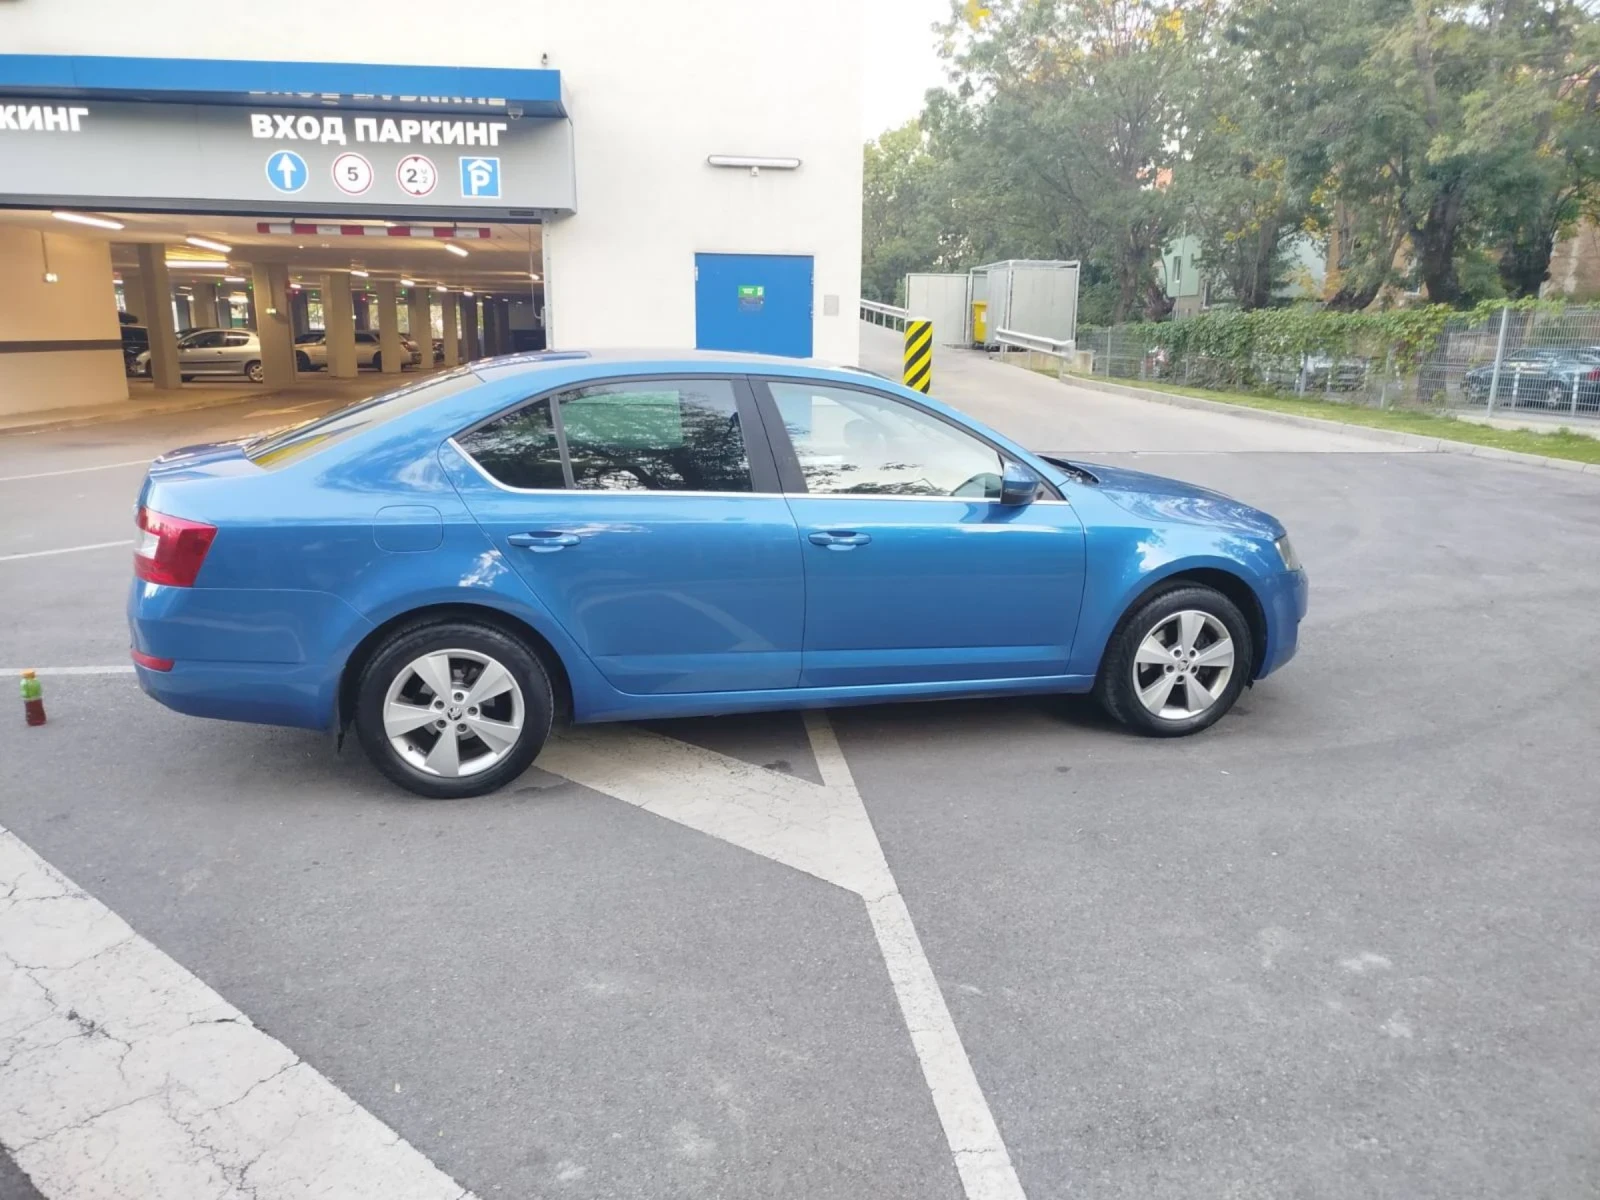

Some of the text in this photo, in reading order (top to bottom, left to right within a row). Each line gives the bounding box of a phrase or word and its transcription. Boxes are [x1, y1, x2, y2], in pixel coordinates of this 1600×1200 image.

[250, 113, 508, 146] ВХОД ПАРКИНГ
[347, 166, 359, 182] 5
